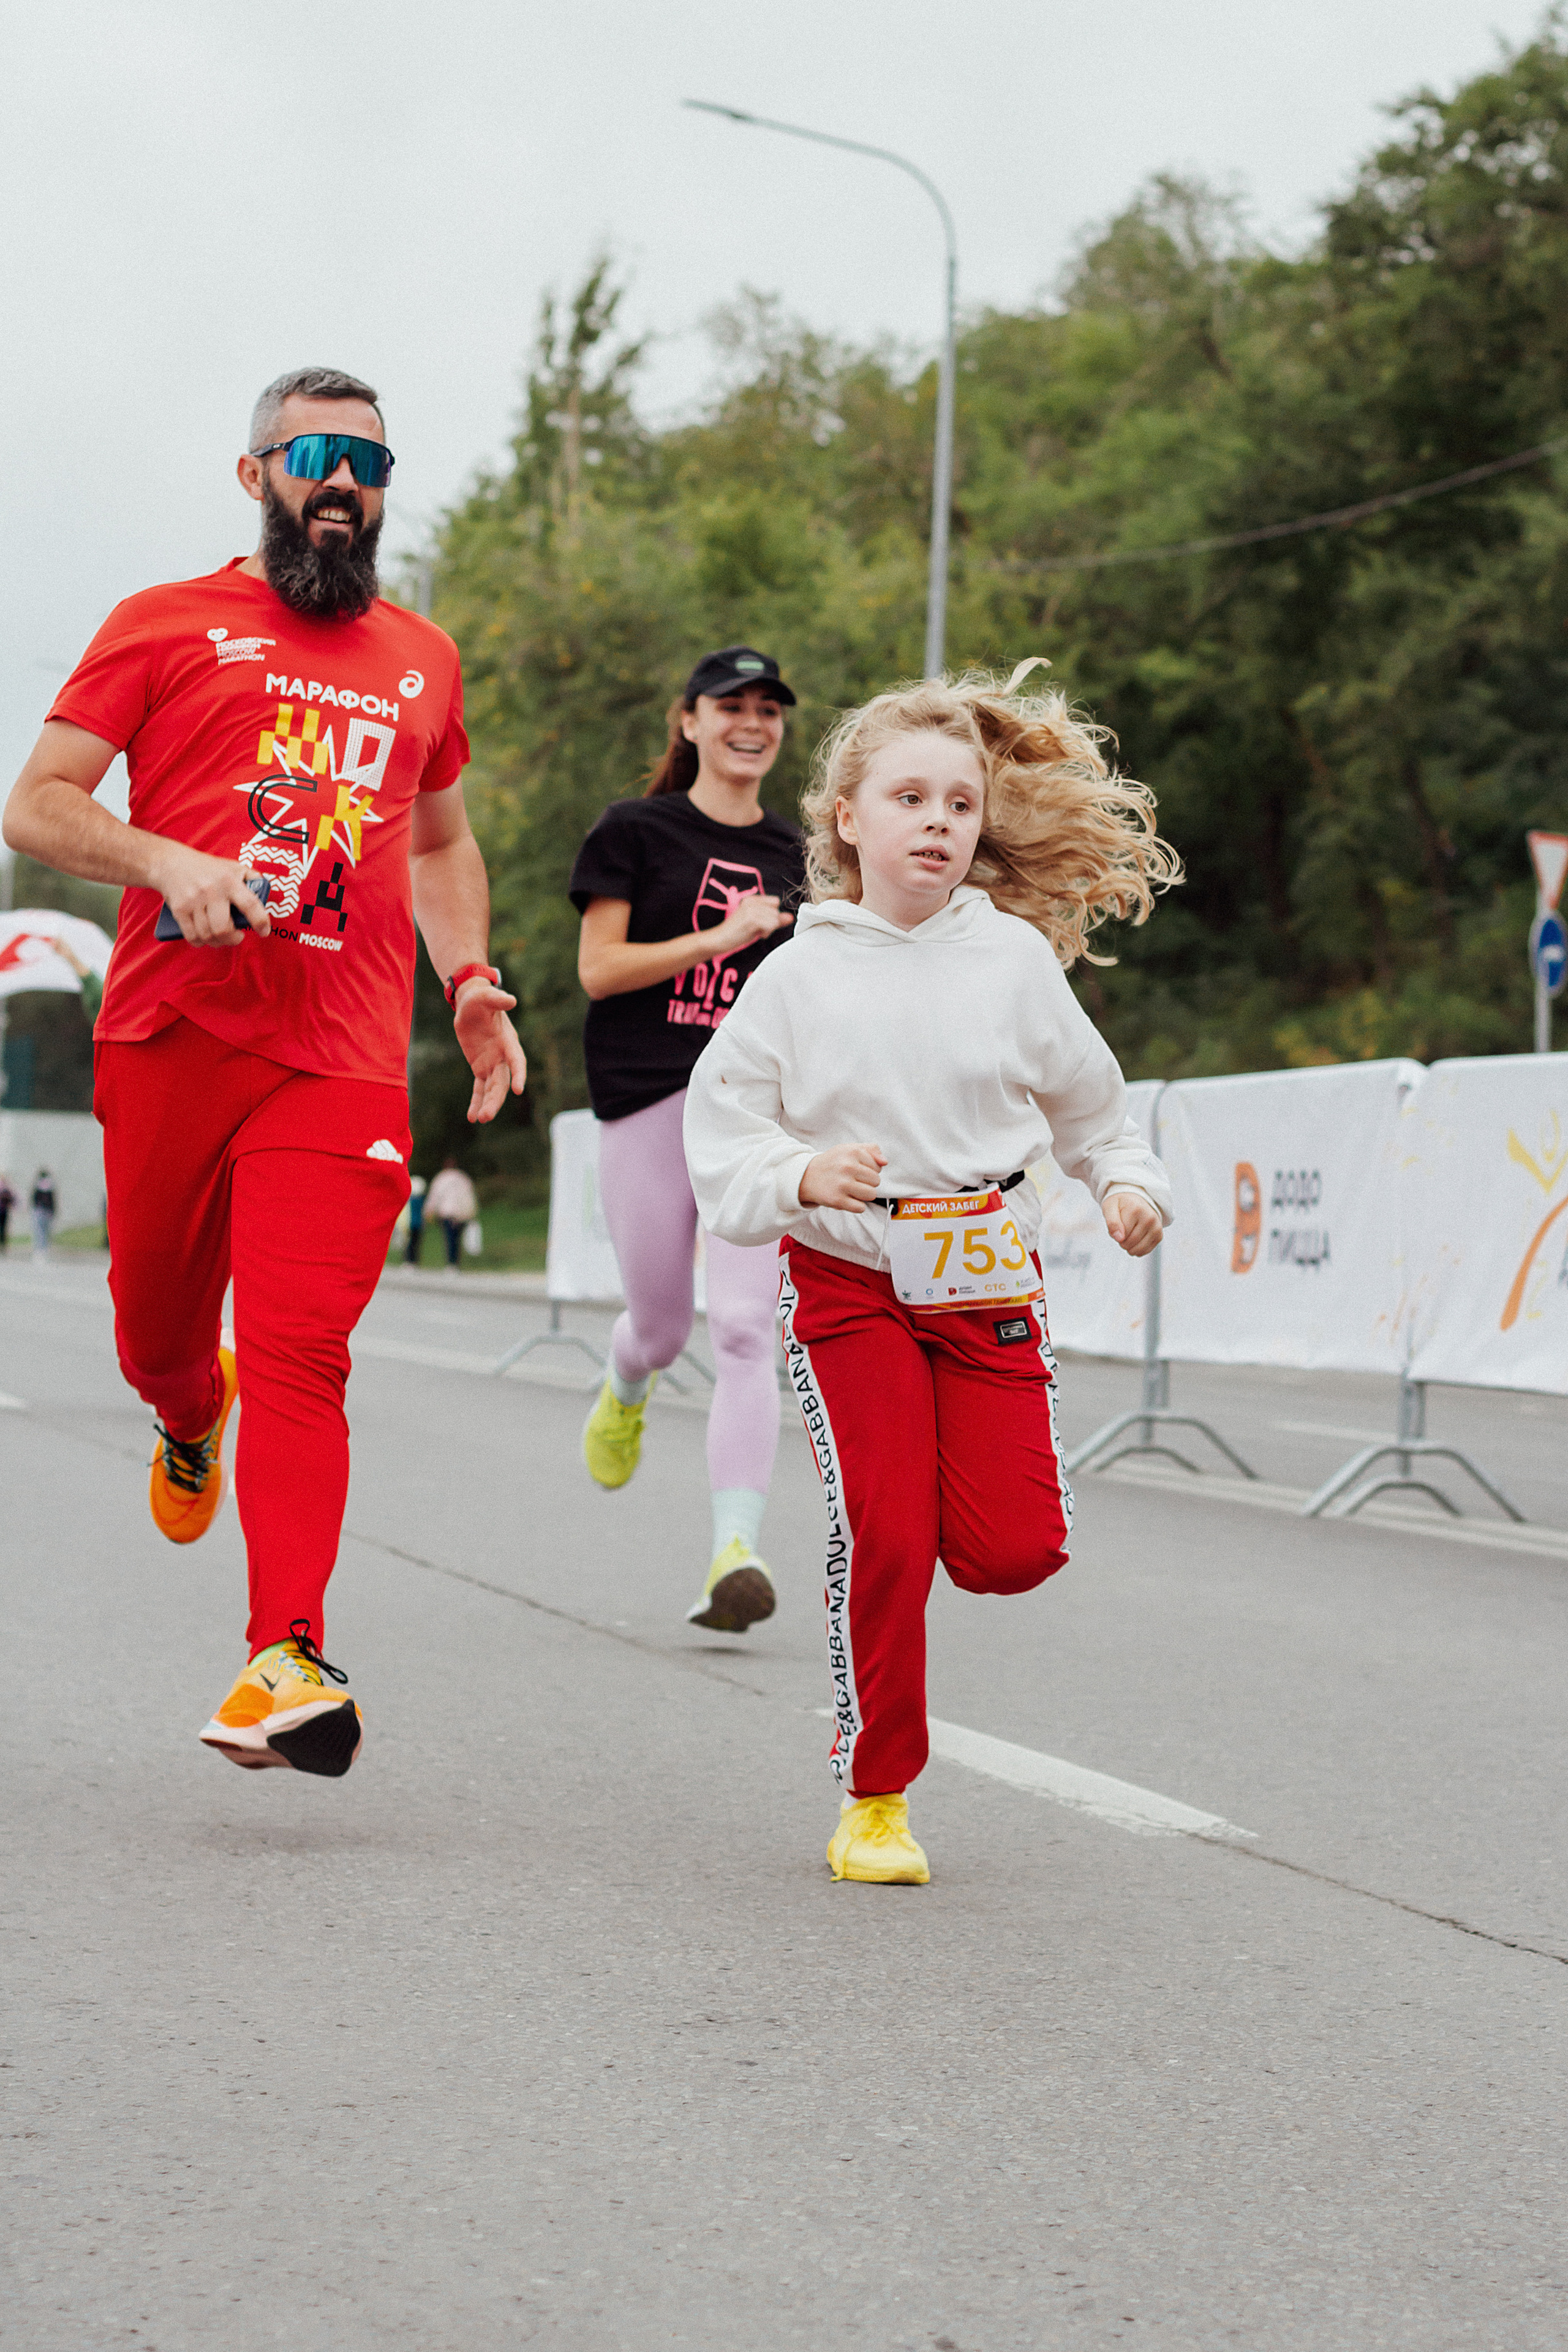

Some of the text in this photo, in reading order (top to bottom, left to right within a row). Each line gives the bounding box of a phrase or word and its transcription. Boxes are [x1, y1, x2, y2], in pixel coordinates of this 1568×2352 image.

[265, 673, 399, 722] МАРАФОН
[299, 932, 343, 951] MOSCOW
[902, 1200, 980, 1215] ДЕТСКИЙ ЗАБЕГ
[1270, 1169, 1322, 1215] ДОДО
[924, 1220, 1027, 1280] 753
[1267, 1228, 1332, 1274] ПИЦЦА
[984, 1283, 1006, 1292] СТС
